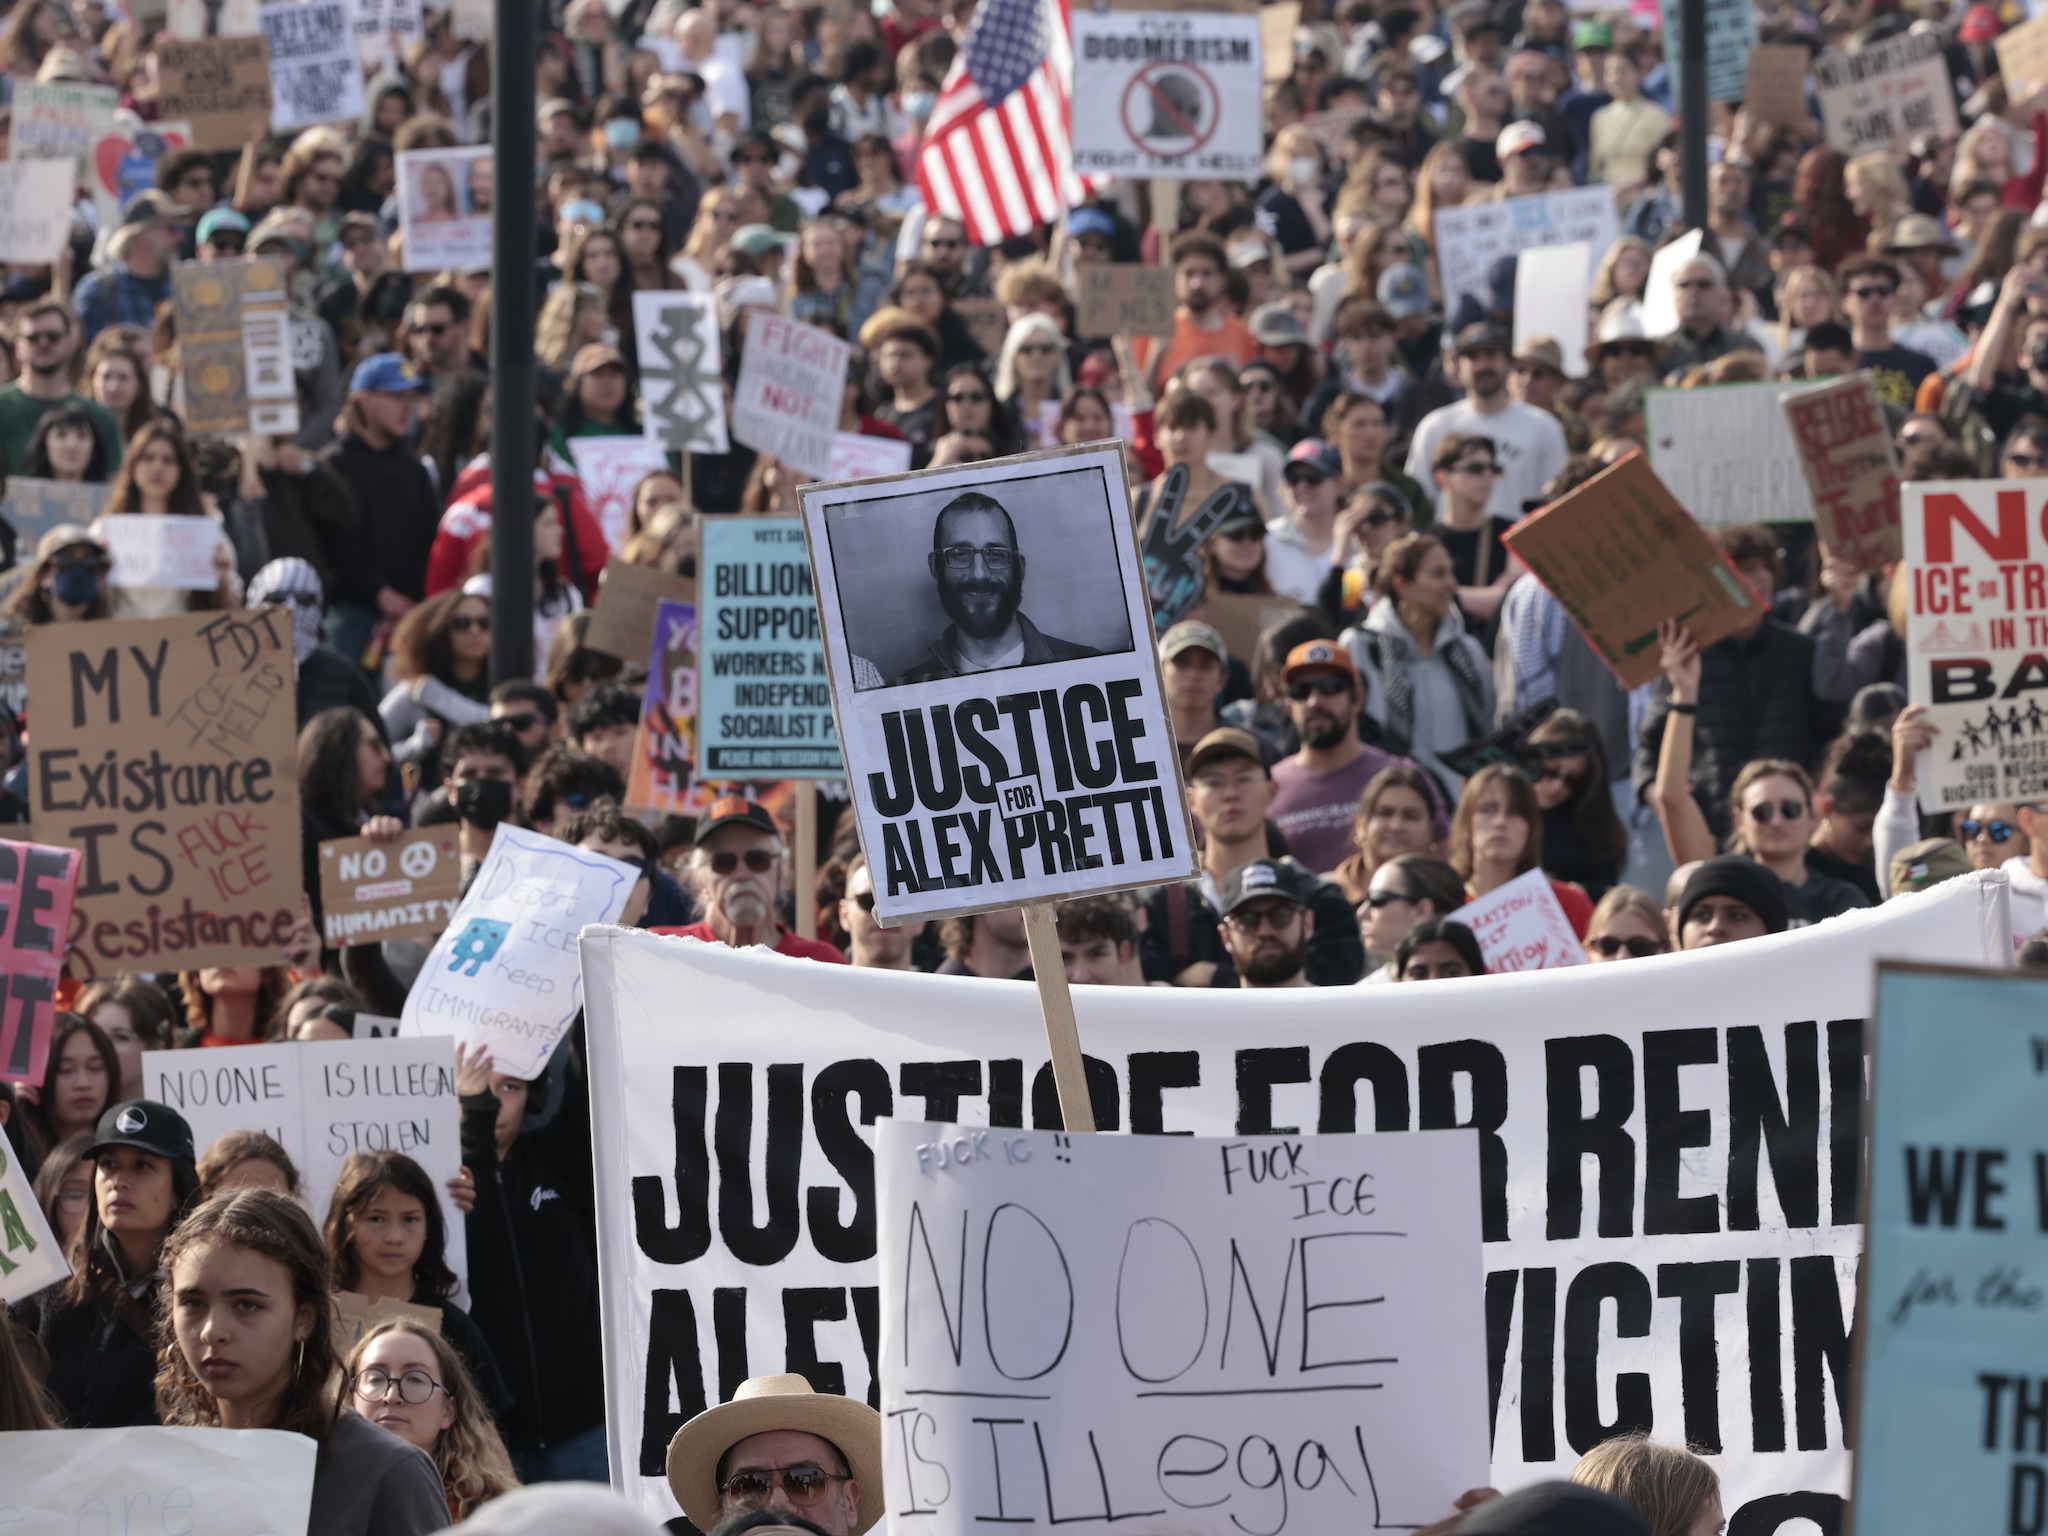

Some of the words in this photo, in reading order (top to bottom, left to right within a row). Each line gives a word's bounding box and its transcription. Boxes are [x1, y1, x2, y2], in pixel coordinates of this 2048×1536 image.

[1083, 34, 1252, 62] DOOMERISM
[761, 317, 844, 375] FIGHT
[761, 383, 814, 421] NOT
[754, 529, 783, 544] VOTE
[787, 529, 807, 545] SO
[1923, 489, 2048, 564] N
[1913, 566, 1973, 616] ICE
[1978, 579, 1998, 599] OR
[197, 609, 283, 672] FDT
[1989, 617, 2017, 651] IN
[69, 638, 169, 728] MY
[712, 650, 806, 677] WORKERS
[812, 651, 827, 677] N
[166, 672, 233, 749] ICE
[720, 713, 817, 740] SOCIALIST
[821, 713, 837, 740] P
[867, 678, 1159, 818] JUSTICE
[1965, 763, 1998, 783] OUR
[39, 749, 274, 814] Existance
[1003, 784, 1037, 812] FOR
[1942, 781, 1998, 803] RIGHTS
[70, 821, 174, 898] IS
[176, 809, 270, 870] FUCK
[339, 848, 388, 882] NO
[882, 809, 1004, 897] ALEX
[1004, 785, 1175, 881] PRETTI
[208, 843, 273, 903] ICE
[480, 855, 584, 918] Deport
[522, 919, 578, 956] ICE
[492, 951, 556, 997] Keep
[420, 986, 561, 1043] IMMIGRANTS
[160, 1069, 206, 1110] NO
[214, 1065, 286, 1106] ONE
[327, 1118, 431, 1156] STOLEN
[915, 1132, 992, 1174] FUCK
[1220, 1142, 1309, 1195] FUCK
[1903, 1144, 2009, 1234] WE
[1290, 1173, 1376, 1220] ICE
[905, 1200, 1074, 1382] NO
[1116, 1216, 1409, 1383] ONE
[1887, 1266, 1957, 1328] for
[887, 1407, 952, 1517] IS
